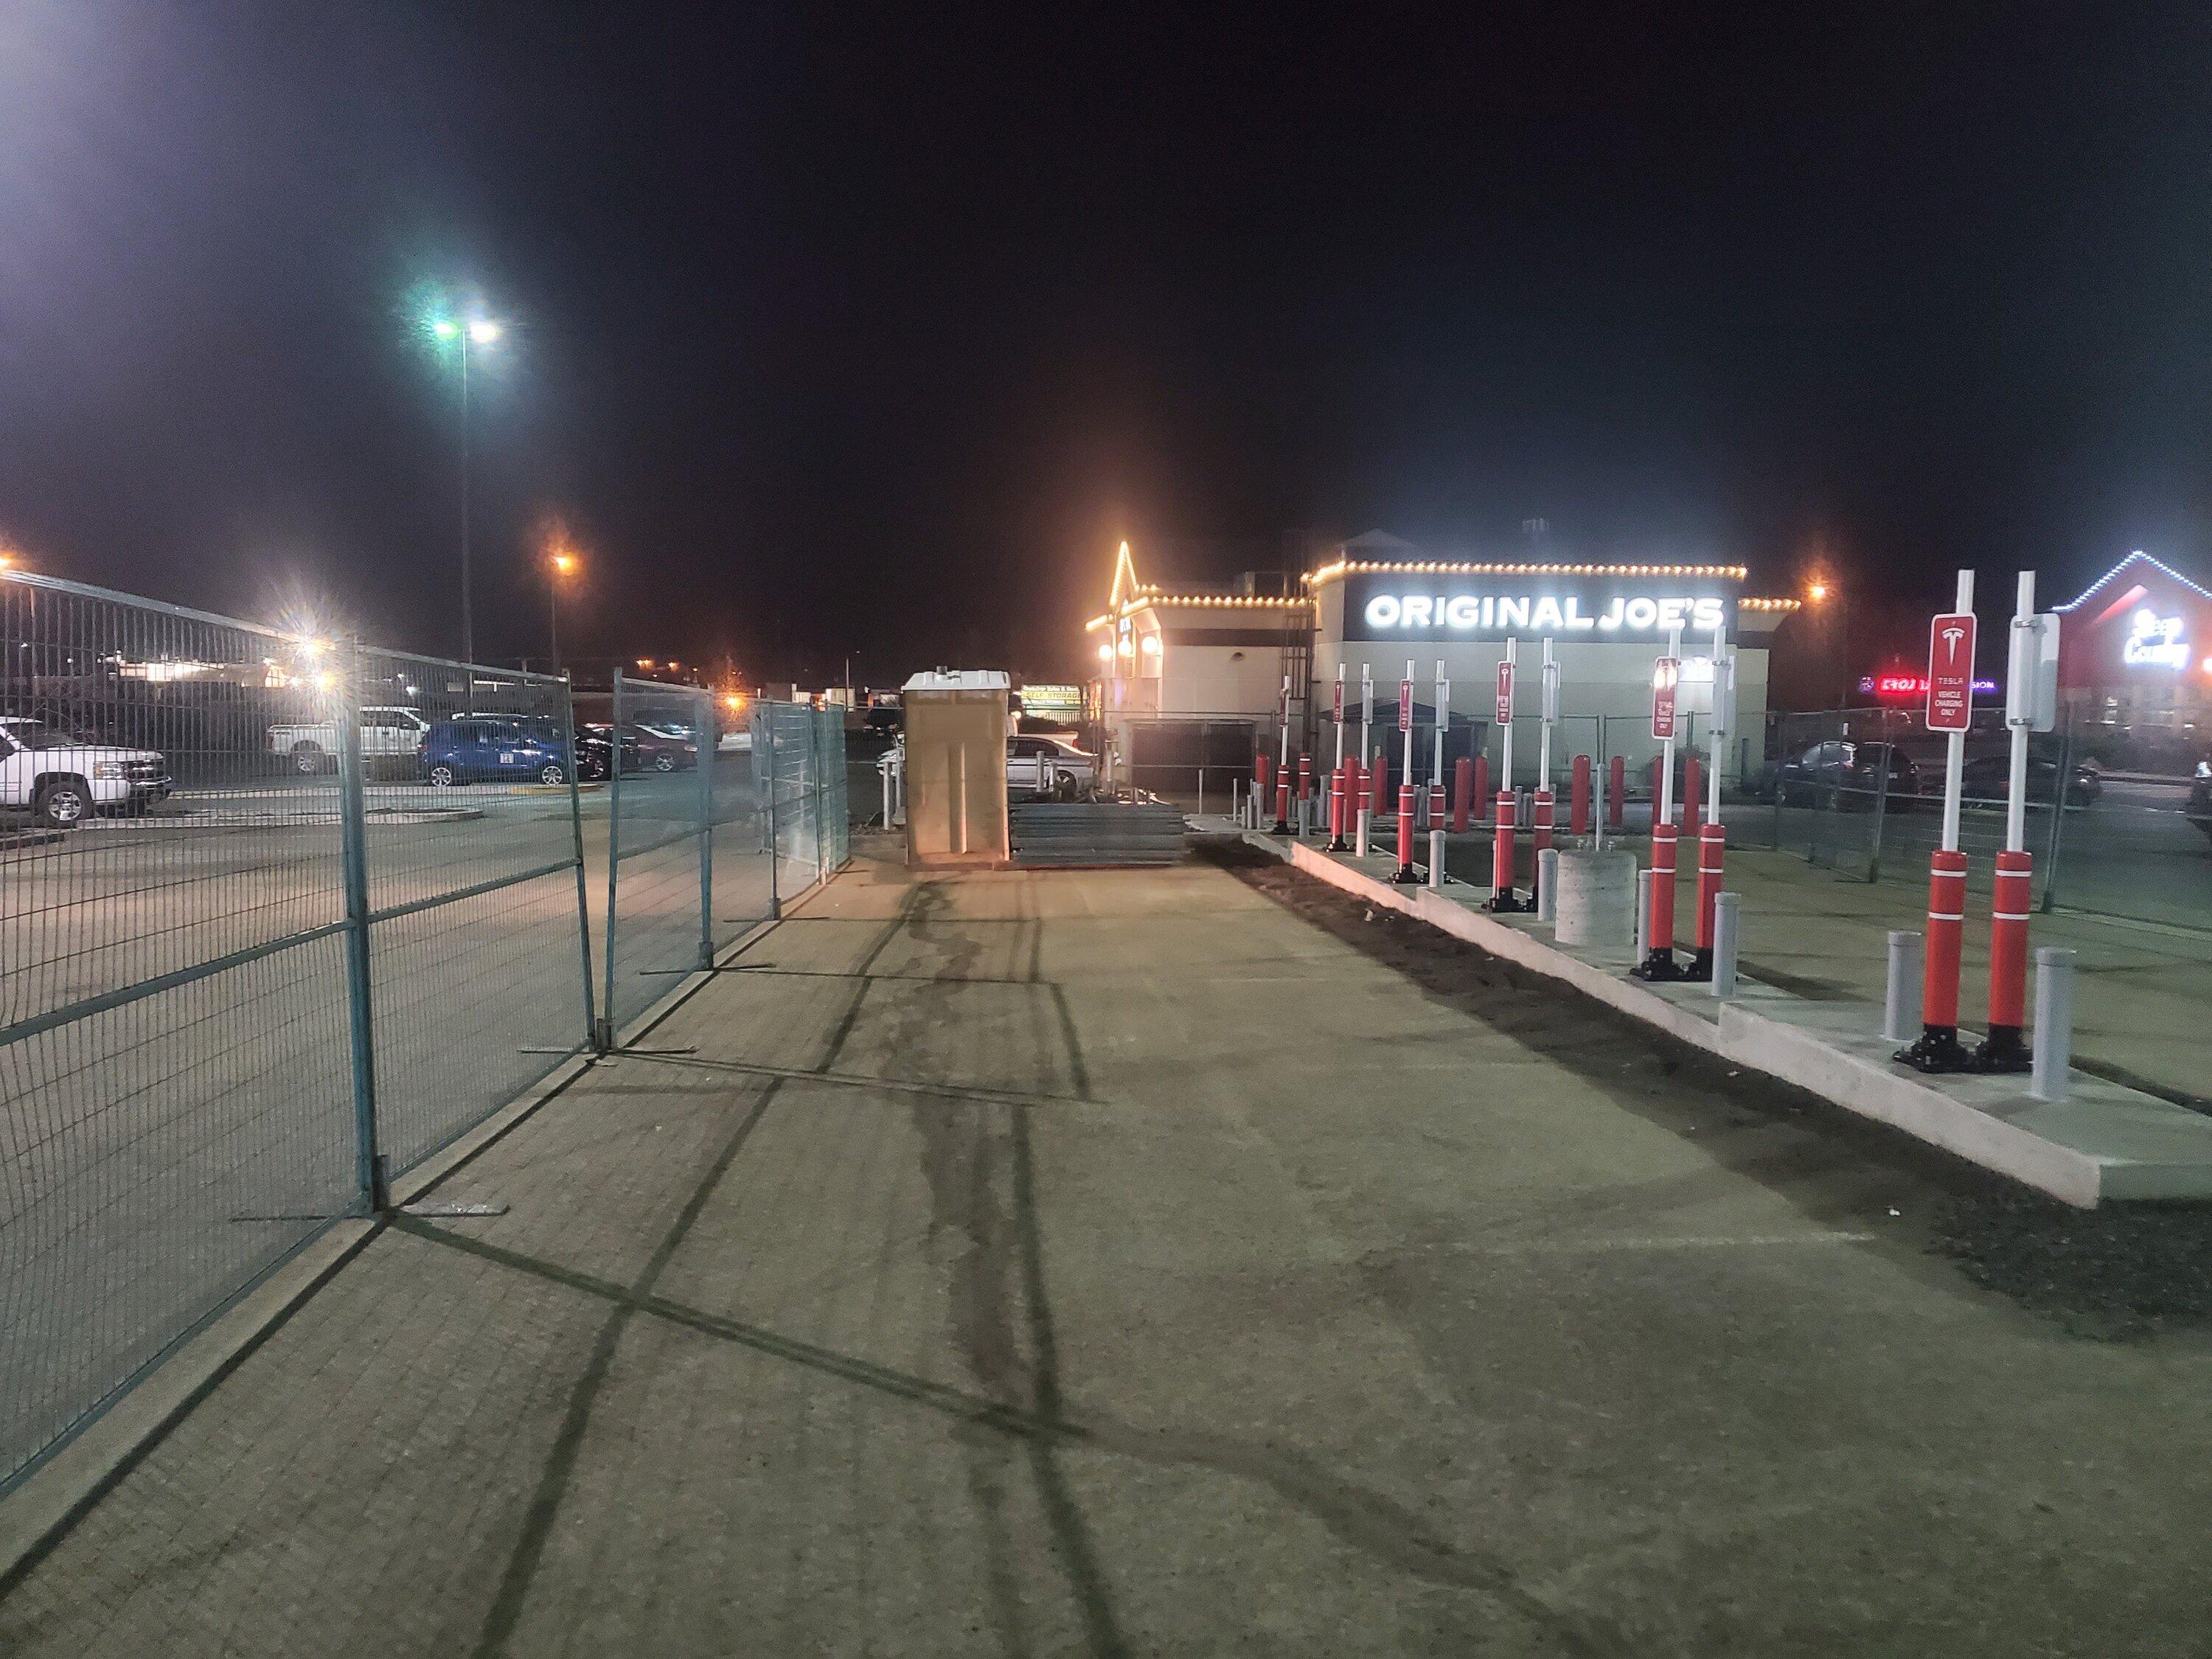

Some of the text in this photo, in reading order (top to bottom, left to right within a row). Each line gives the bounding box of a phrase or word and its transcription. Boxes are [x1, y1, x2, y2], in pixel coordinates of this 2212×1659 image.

[1366, 595, 1724, 630] ORIGINAL JOE'S
[1938, 677, 1964, 685] TESLA
[1938, 690, 1962, 699] VEHICLE
[1934, 699, 1964, 708] CHARGING
[1941, 708, 1957, 716] ONLY
